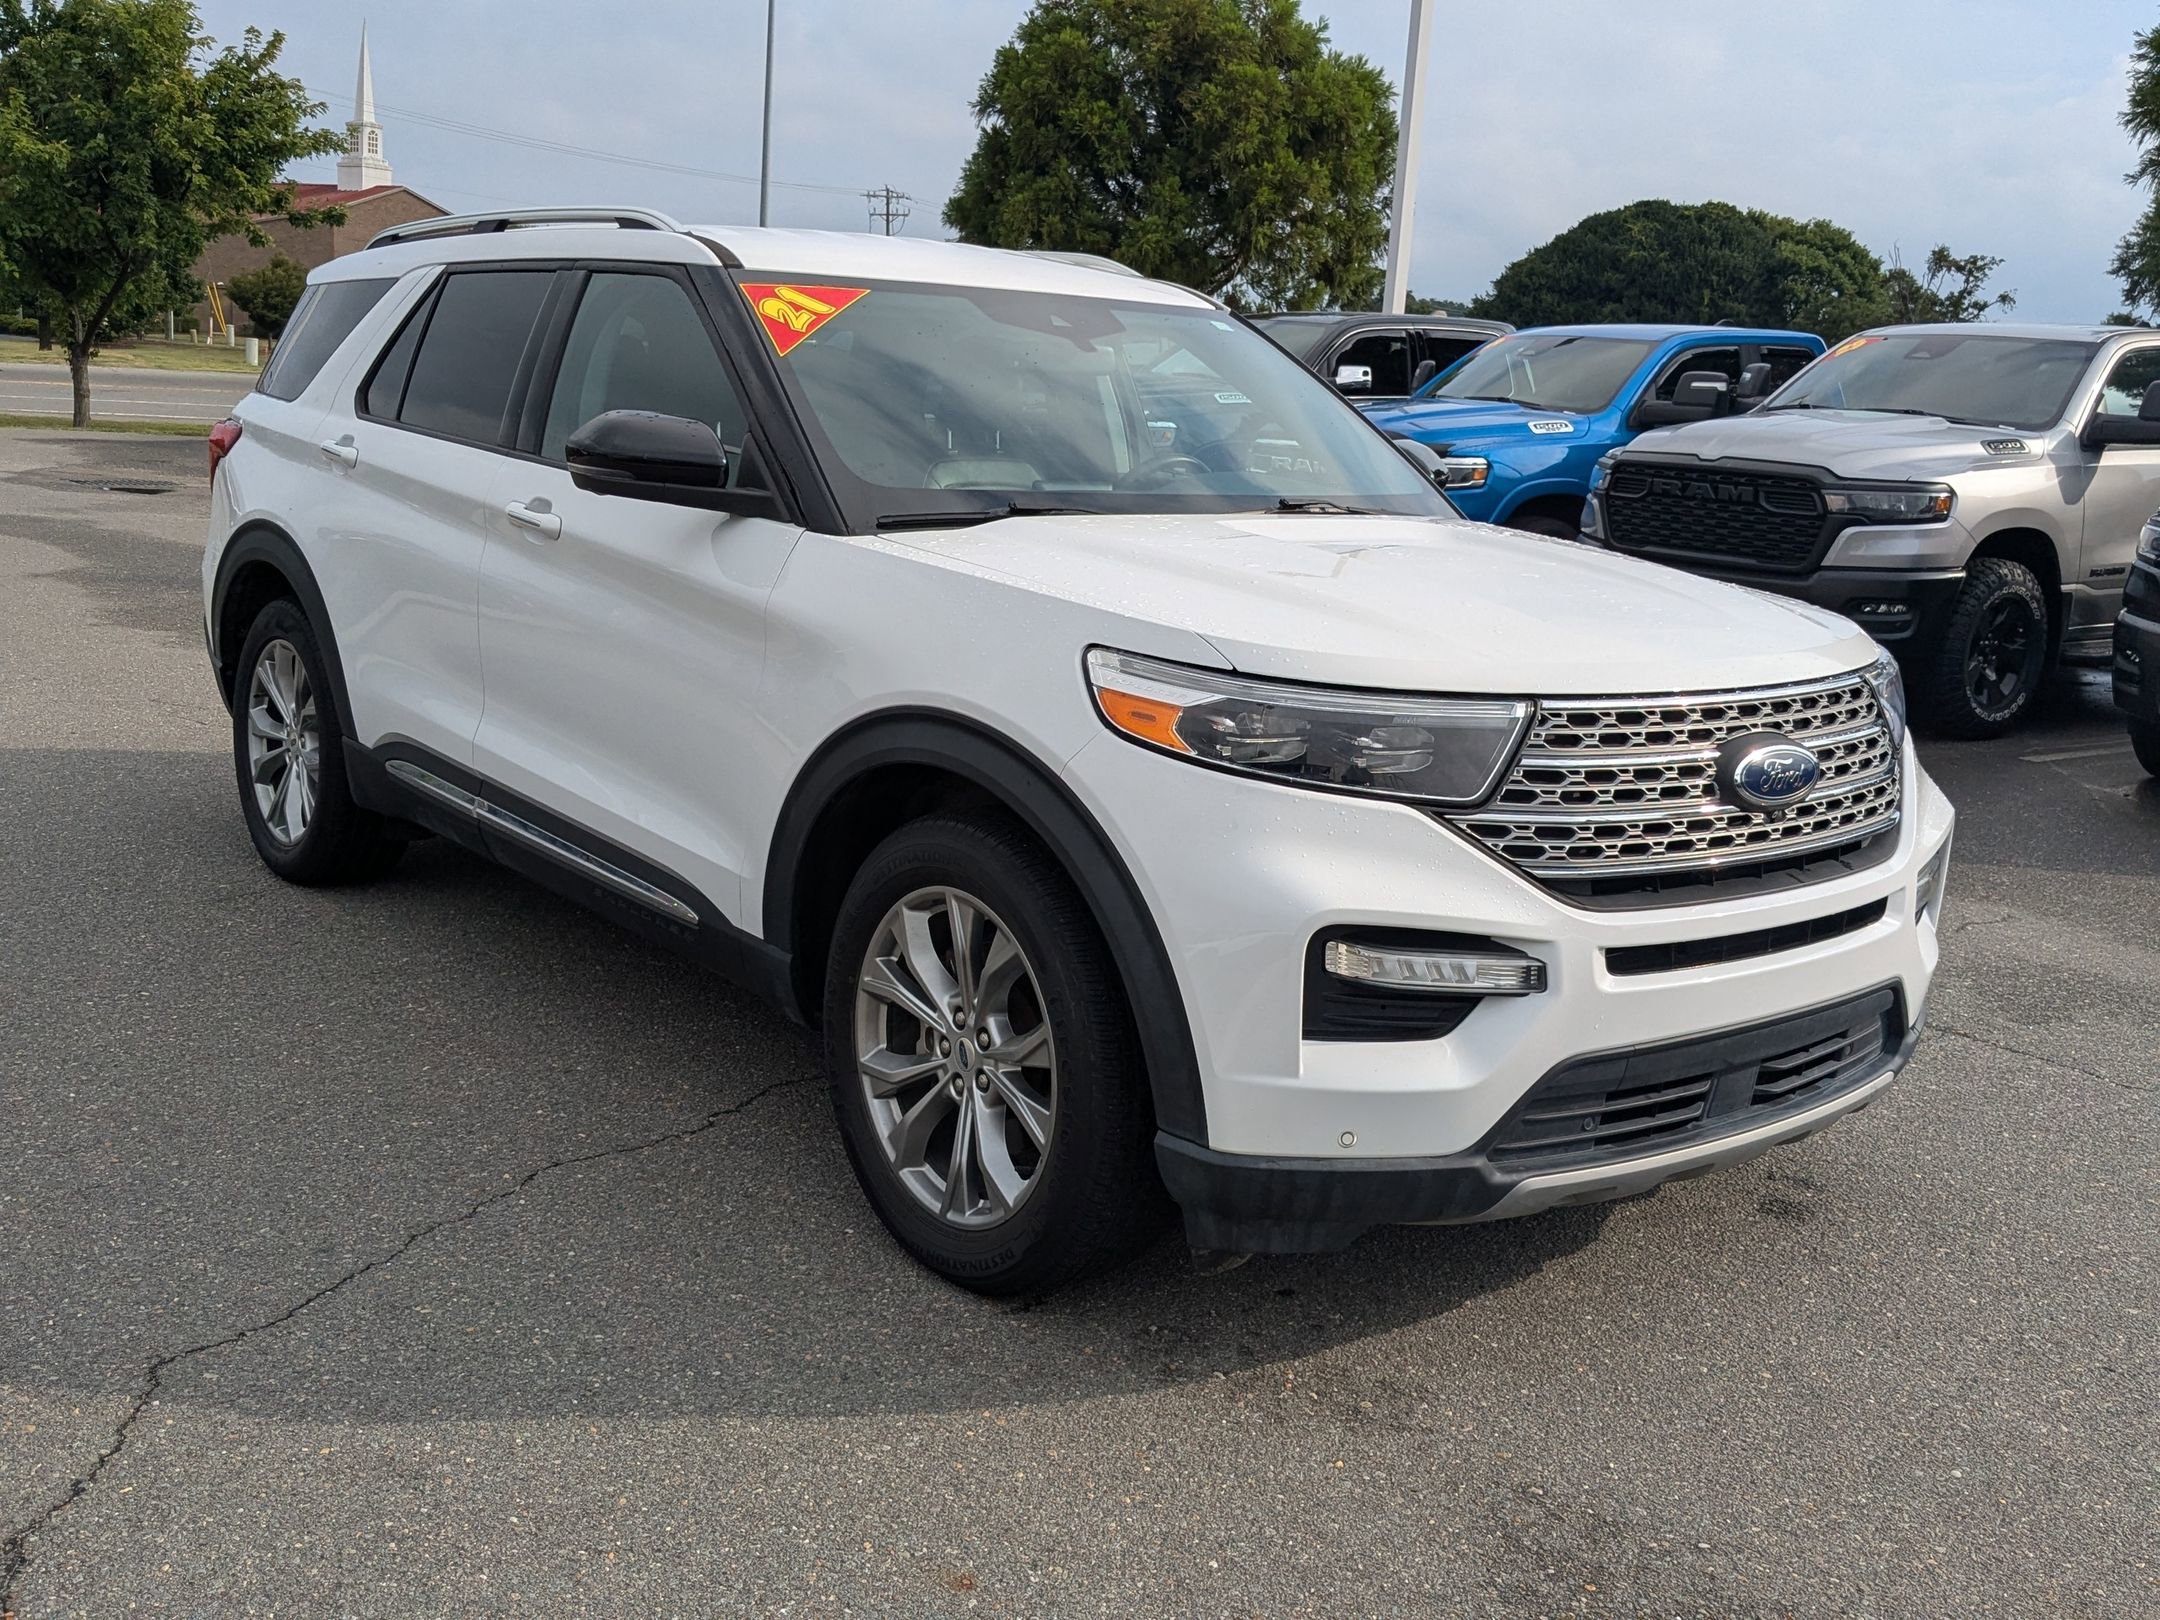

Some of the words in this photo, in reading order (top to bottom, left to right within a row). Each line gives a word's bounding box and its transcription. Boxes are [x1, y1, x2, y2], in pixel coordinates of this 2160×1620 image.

[758, 286, 836, 333] 21
[1988, 441, 2021, 449] 1500
[1652, 477, 1754, 501] RAM
[1760, 757, 1806, 792] Ford
